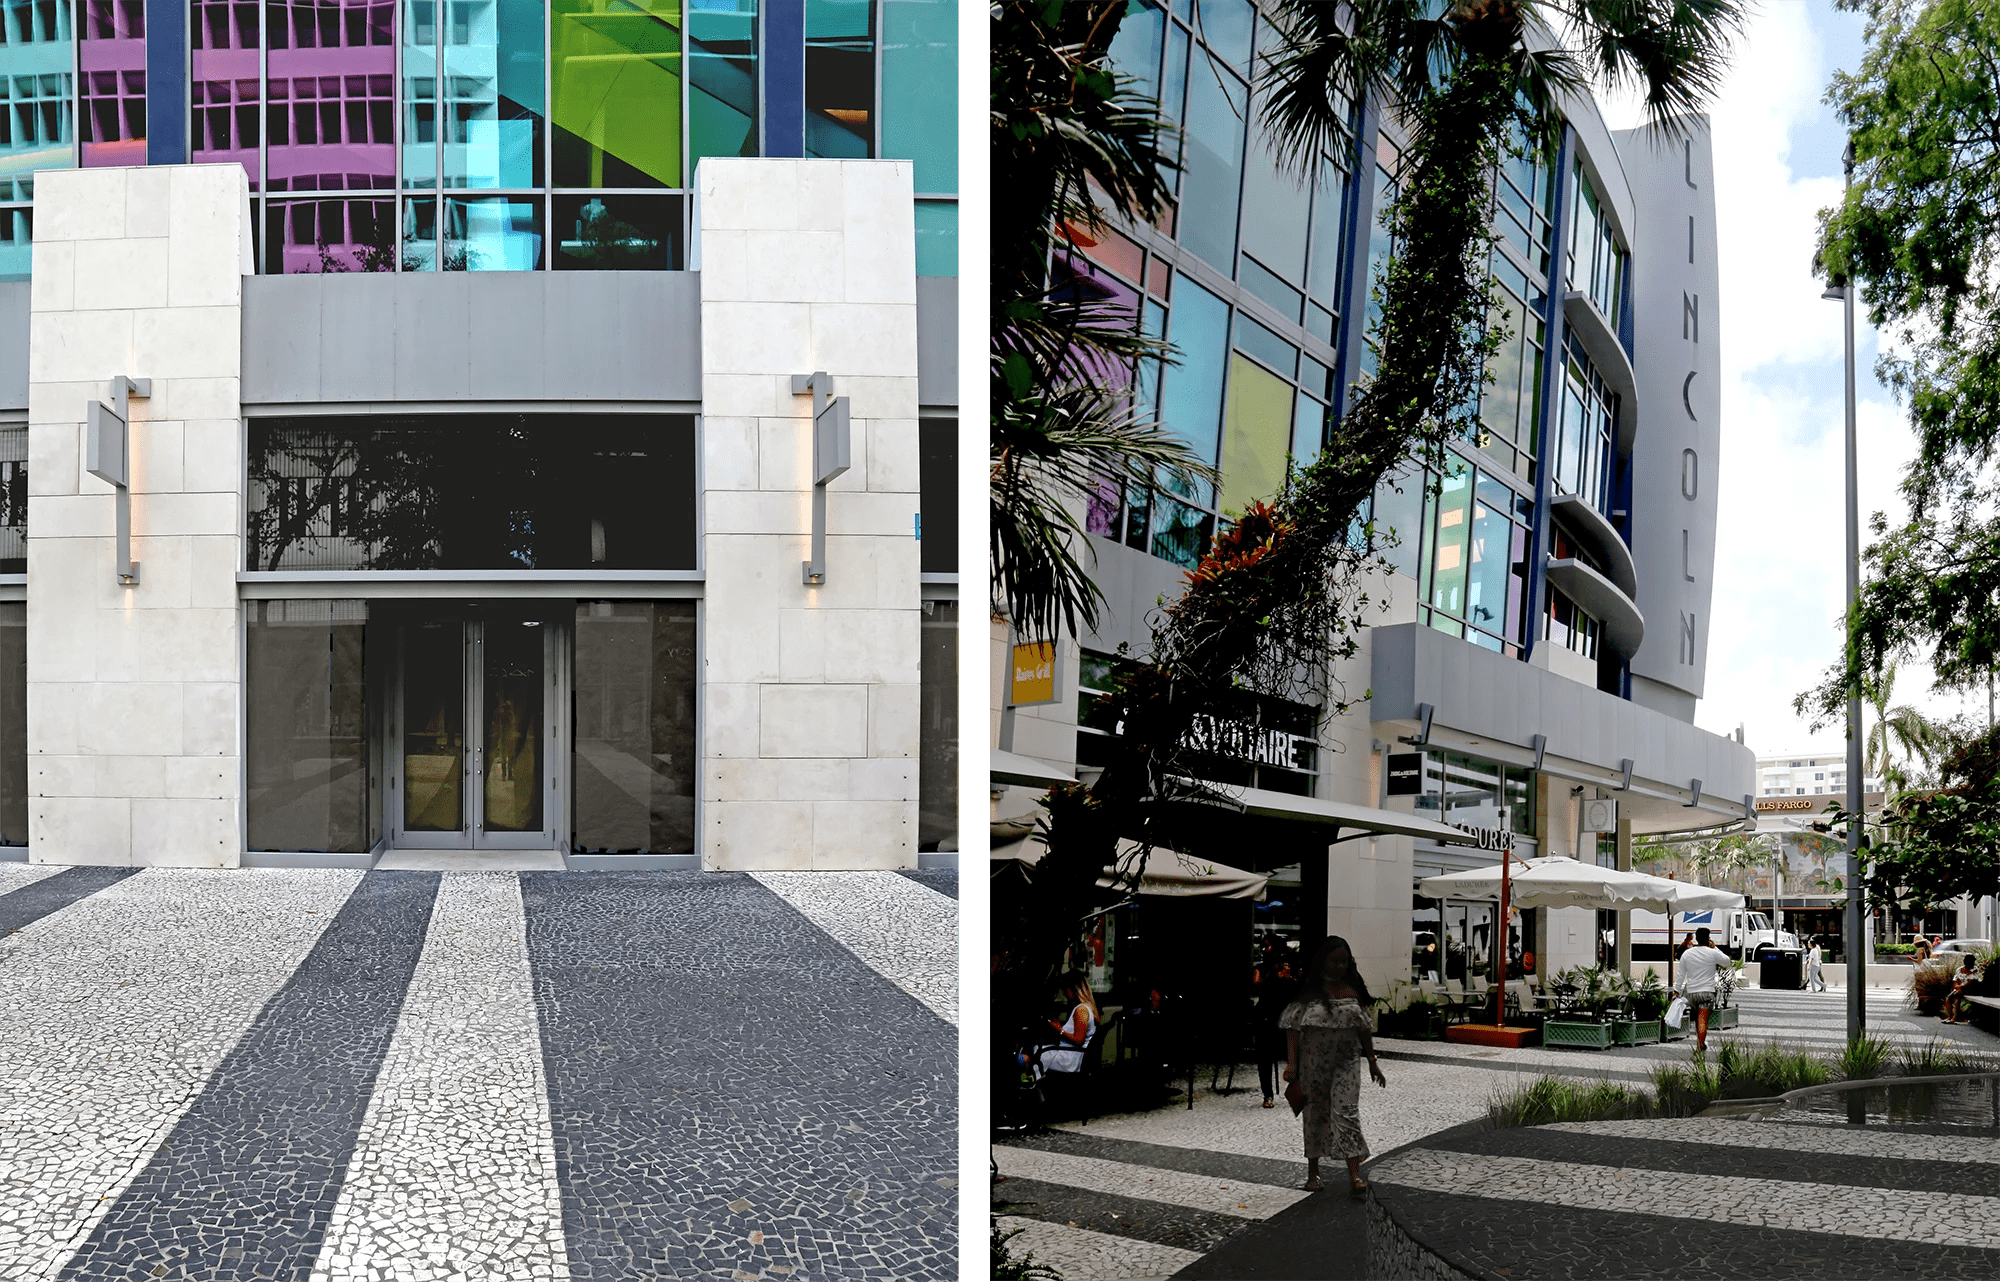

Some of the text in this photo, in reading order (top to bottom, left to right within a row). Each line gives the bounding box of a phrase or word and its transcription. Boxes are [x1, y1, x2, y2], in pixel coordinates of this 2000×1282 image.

[1680, 139, 1699, 666] LINCOLN
[1757, 800, 1812, 811] LLS FARGO
